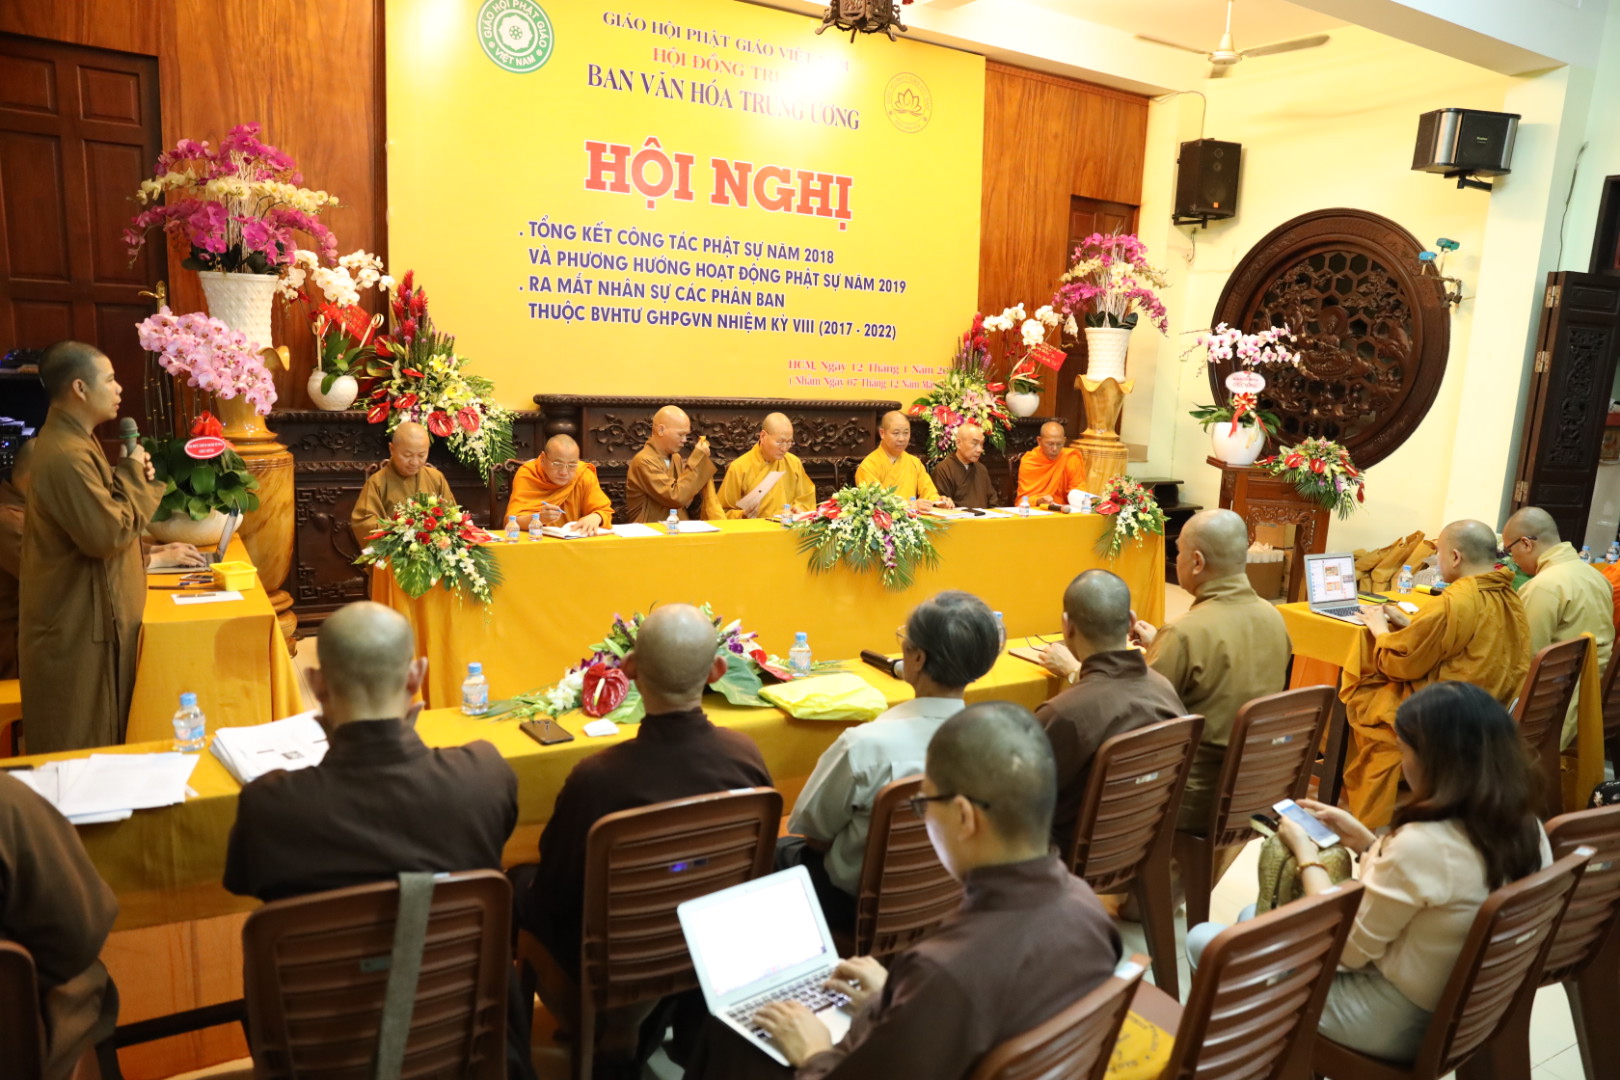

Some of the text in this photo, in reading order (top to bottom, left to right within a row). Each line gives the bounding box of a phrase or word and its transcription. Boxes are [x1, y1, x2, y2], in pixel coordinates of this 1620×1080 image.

[482, 11, 495, 39] GIÁO
[536, 21, 550, 48] GIÁO
[602, 11, 647, 31] GIÁO
[652, 20, 681, 40] HỘI
[687, 28, 731, 49] PHẬT
[735, 38, 775, 56] GIÁO
[515, 54, 537, 66] NAM
[653, 46, 686, 68] HỘI
[693, 53, 745, 77] ĐỒNG
[588, 63, 634, 93] BAN
[640, 71, 685, 101] VĂN
[691, 79, 733, 109] HÓA
[739, 90, 805, 121] TRUNG
[810, 102, 860, 130] ƯƠNG
[584, 136, 853, 231] HỘI NGHỊ
[528, 215, 577, 241] TỔNG
[582, 221, 613, 244] KẾT
[617, 226, 665, 249] CÔNG
[669, 231, 698, 252] TÁC
[703, 236, 740, 258] PHẬT
[744, 241, 764, 261] SỰ
[767, 243, 800, 261] NĂM
[804, 248, 834, 264] 2018
[528, 245, 907, 294] VÀ PHƯƠNG HƯỚNG HOẠT ĐỘNG PHẬT SỰ NĂM 2019
[529, 275, 552, 292] RA
[557, 272, 593, 295] MẮT
[598, 278, 645, 298] NHÂN
[651, 283, 672, 303] SỰ
[675, 283, 707, 302] CÁC
[711, 286, 752, 306] PHÂN
[756, 292, 785, 308] BAN
[528, 300, 586, 324] THUỘC
[591, 306, 643, 324] BVHTƯ
[646, 310, 712, 328] GHPGVN
[717, 312, 767, 334] NHIỆM
[771, 313, 789, 332] KỲ
[793, 318, 814, 334] VIII
[819, 321, 853, 336] (2017
[864, 323, 897, 340] 2022)
[788, 360, 817, 371] HCM,
[820, 360, 847, 373] Ngày
[852, 363, 864, 372] 12
[868, 363, 900, 376] Tháng
[912, 364, 934, 375] Năm
[823, 376, 844, 389] Ngày
[847, 378, 859, 387] 07
[862, 378, 887, 390] Tháng
[890, 380, 899, 388] 12
